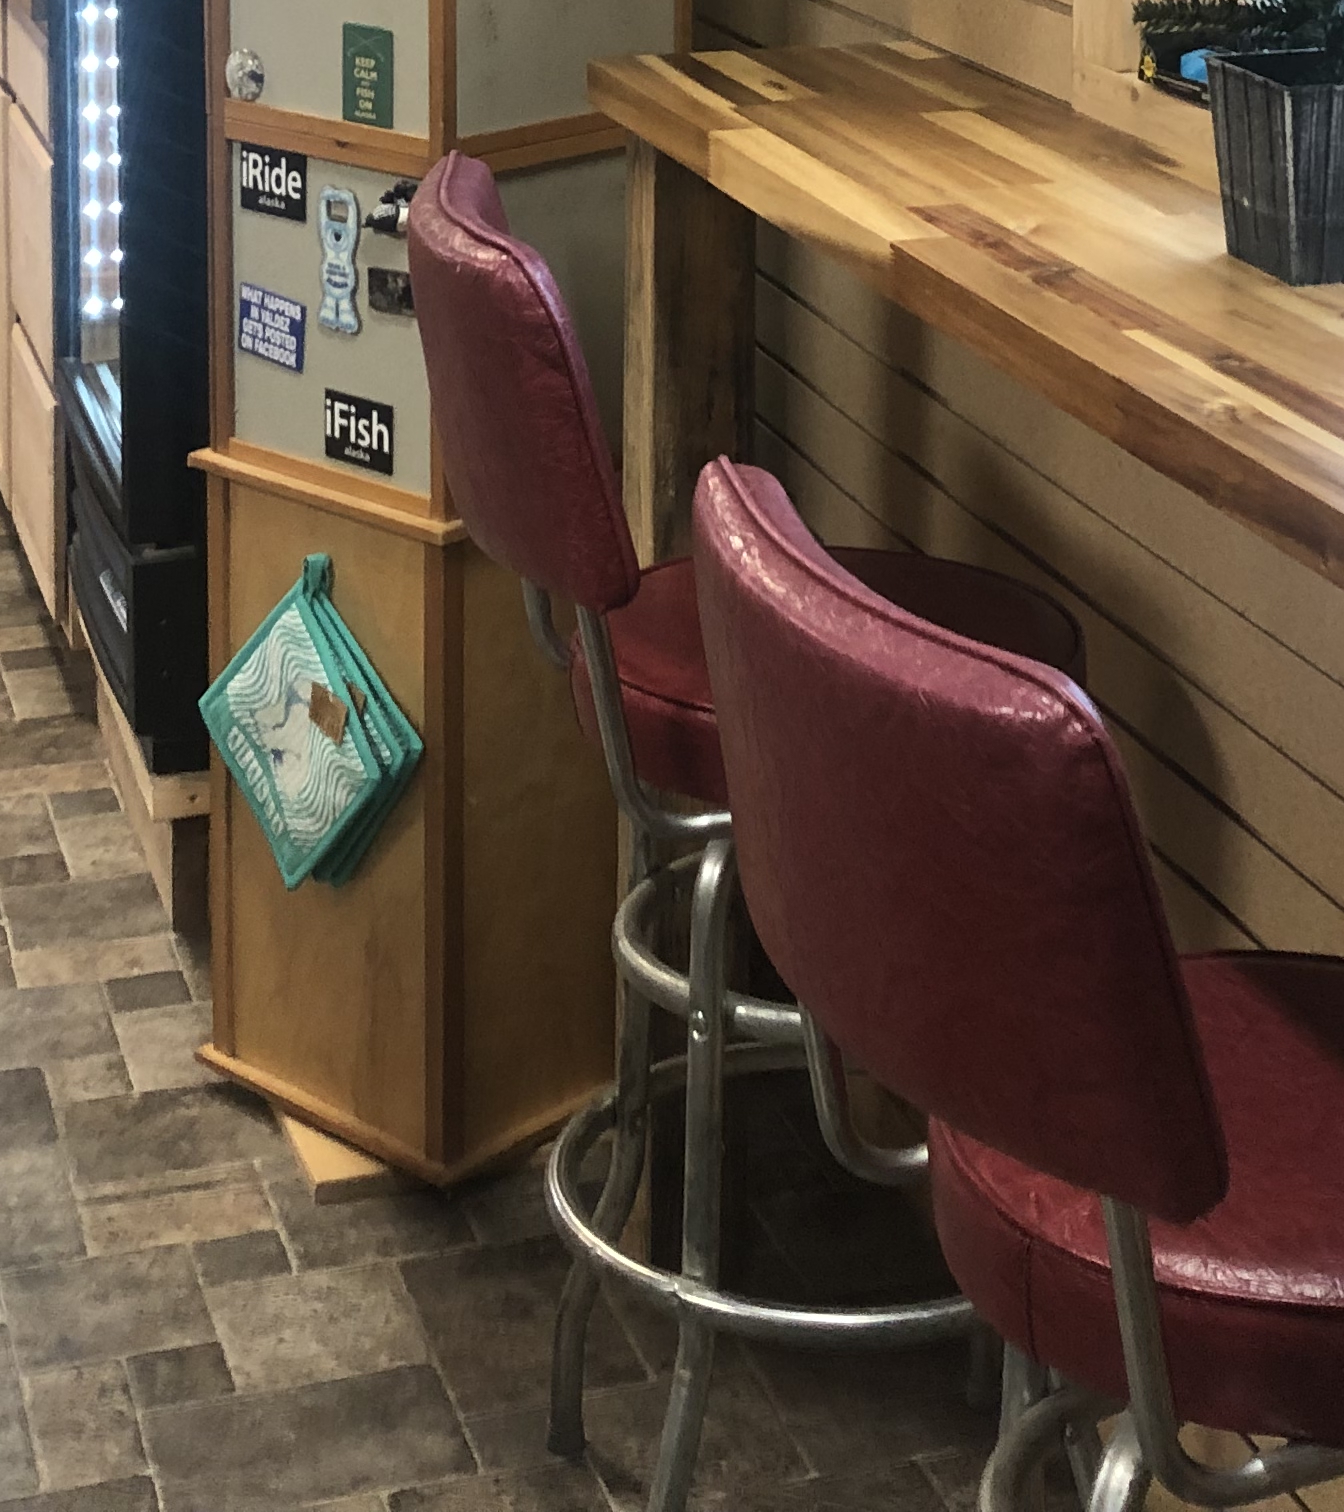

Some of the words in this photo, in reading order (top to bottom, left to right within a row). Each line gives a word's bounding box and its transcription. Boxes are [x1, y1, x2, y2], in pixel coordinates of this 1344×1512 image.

[355, 56, 375, 68] KEEP
[354, 68, 378, 81] CALM
[356, 87, 375, 99] FISH
[359, 99, 373, 111] ON
[242, 150, 302, 199] iRide
[258, 194, 286, 209] alaska
[241, 285, 263, 305] WHAT
[263, 293, 302, 321] HAPPENS
[250, 304, 259, 320] IN
[260, 307, 291, 333] VALDEZ
[242, 317, 264, 339] GETS
[264, 325, 297, 352] POSTED
[241, 333, 253, 350] ON
[253, 339, 297, 368] FACEBOOK
[326, 398, 389, 454] iFish
[344, 446, 371, 463] alaska
